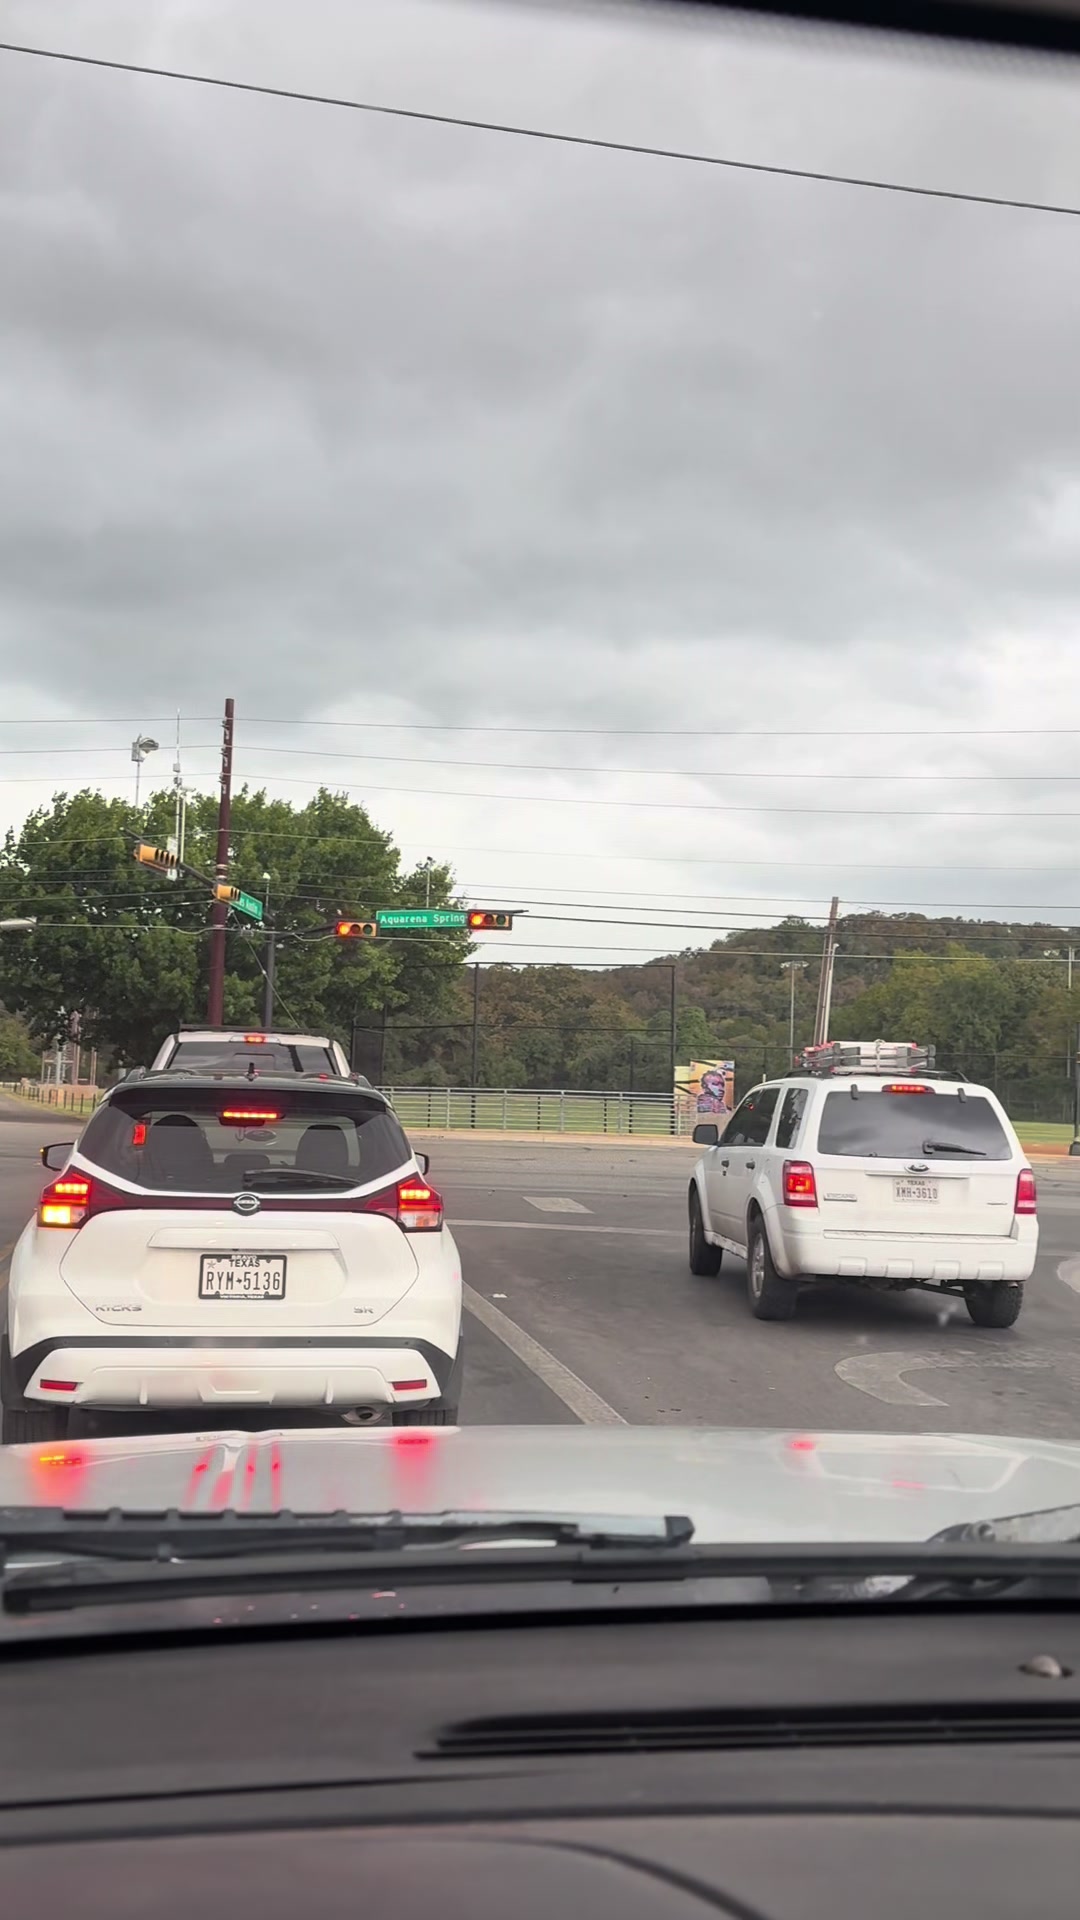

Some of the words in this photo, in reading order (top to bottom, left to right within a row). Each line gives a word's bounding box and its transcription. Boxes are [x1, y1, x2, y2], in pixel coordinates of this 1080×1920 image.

[380, 915, 427, 924] Aquarena
[433, 914, 467, 923] Spring
[229, 1259, 260, 1268] TEXAS
